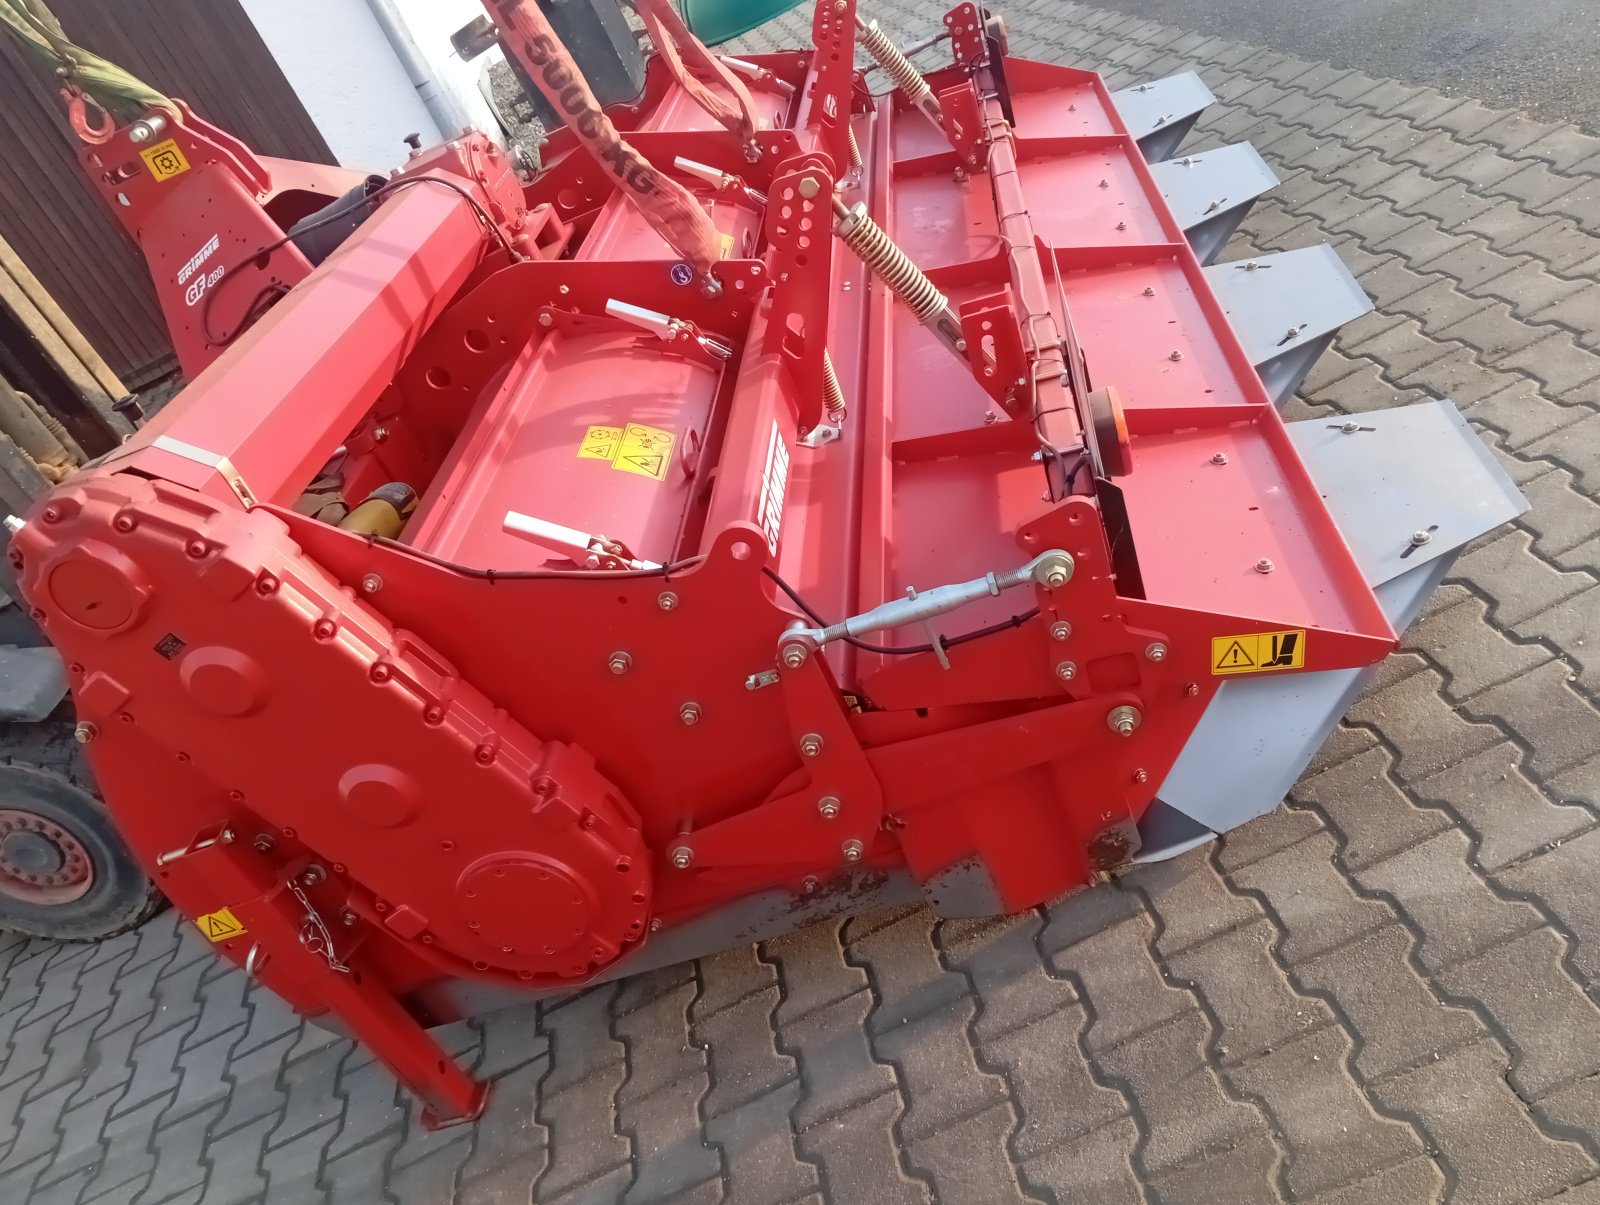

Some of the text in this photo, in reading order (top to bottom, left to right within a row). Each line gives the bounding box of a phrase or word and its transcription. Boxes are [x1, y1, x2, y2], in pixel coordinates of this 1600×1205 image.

[524, 33, 603, 139] 5000
[602, 142, 661, 195] KG
[177, 233, 220, 285] GRIMME
[186, 265, 225, 306] GF 400
[757, 417, 790, 558] GRIMME
